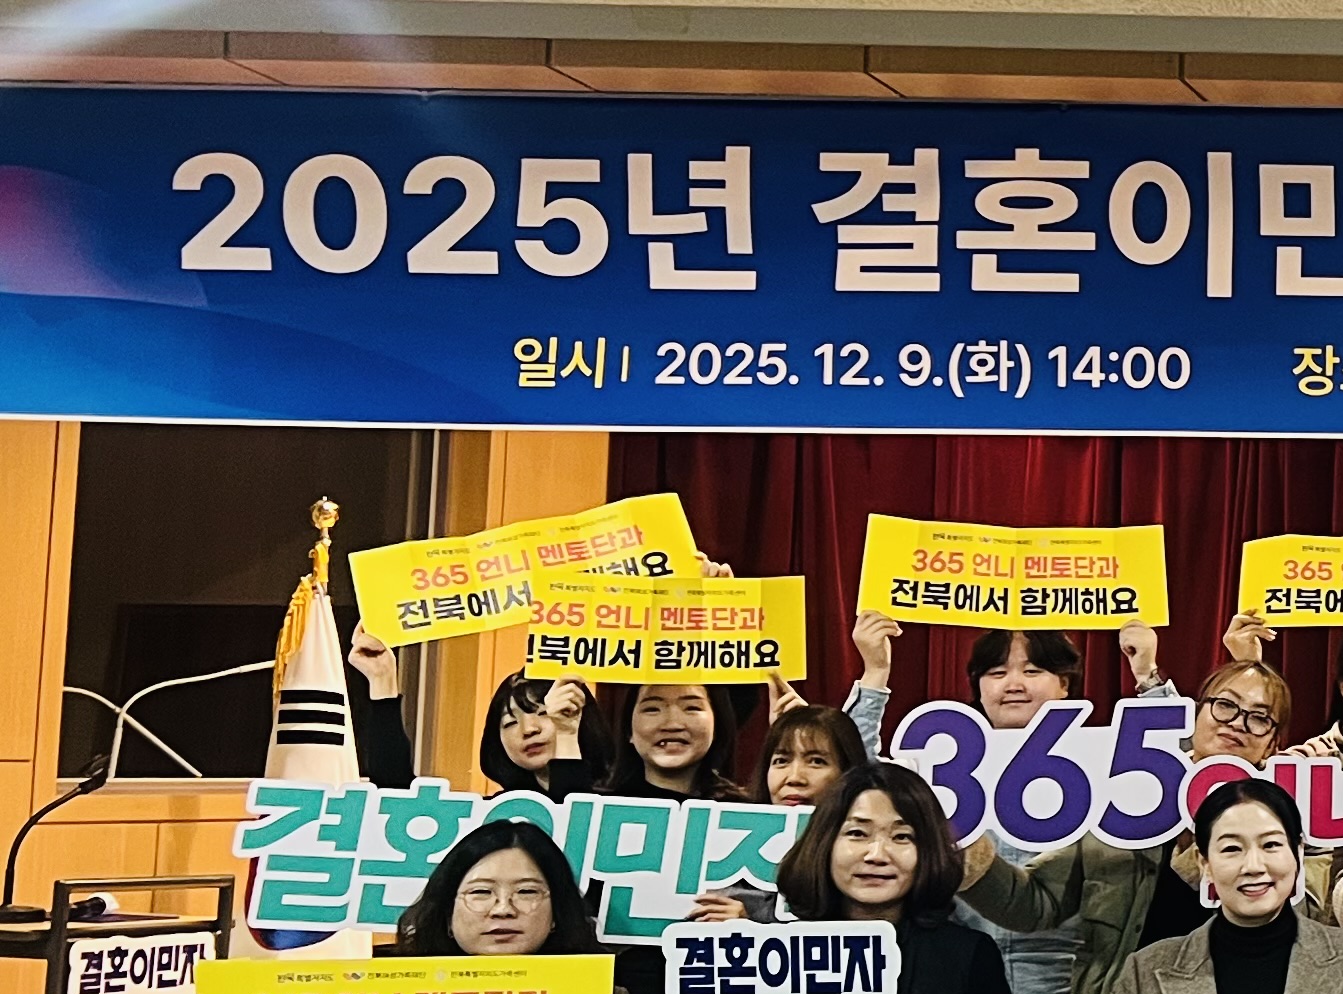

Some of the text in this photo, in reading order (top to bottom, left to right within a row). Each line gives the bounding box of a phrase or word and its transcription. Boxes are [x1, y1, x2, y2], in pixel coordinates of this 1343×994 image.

[173, 146, 756, 290] 2025년
[514, 337, 1190, 398] 일시 2025. 12. 9.(화) 14:00
[413, 565, 469, 589] 365
[478, 550, 528, 579] 언니
[538, 526, 642, 566] 멘토단과
[913, 549, 1119, 578] 365 언니 멘토단과
[1284, 560, 1332, 580] 365
[397, 579, 532, 630] 전북에서
[528, 601, 764, 631] 365 언니 멘토단과
[891, 579, 1138, 615] 전북에서 함께해요
[655, 640, 780, 669] 함께해요
[899, 705, 1188, 844] 365
